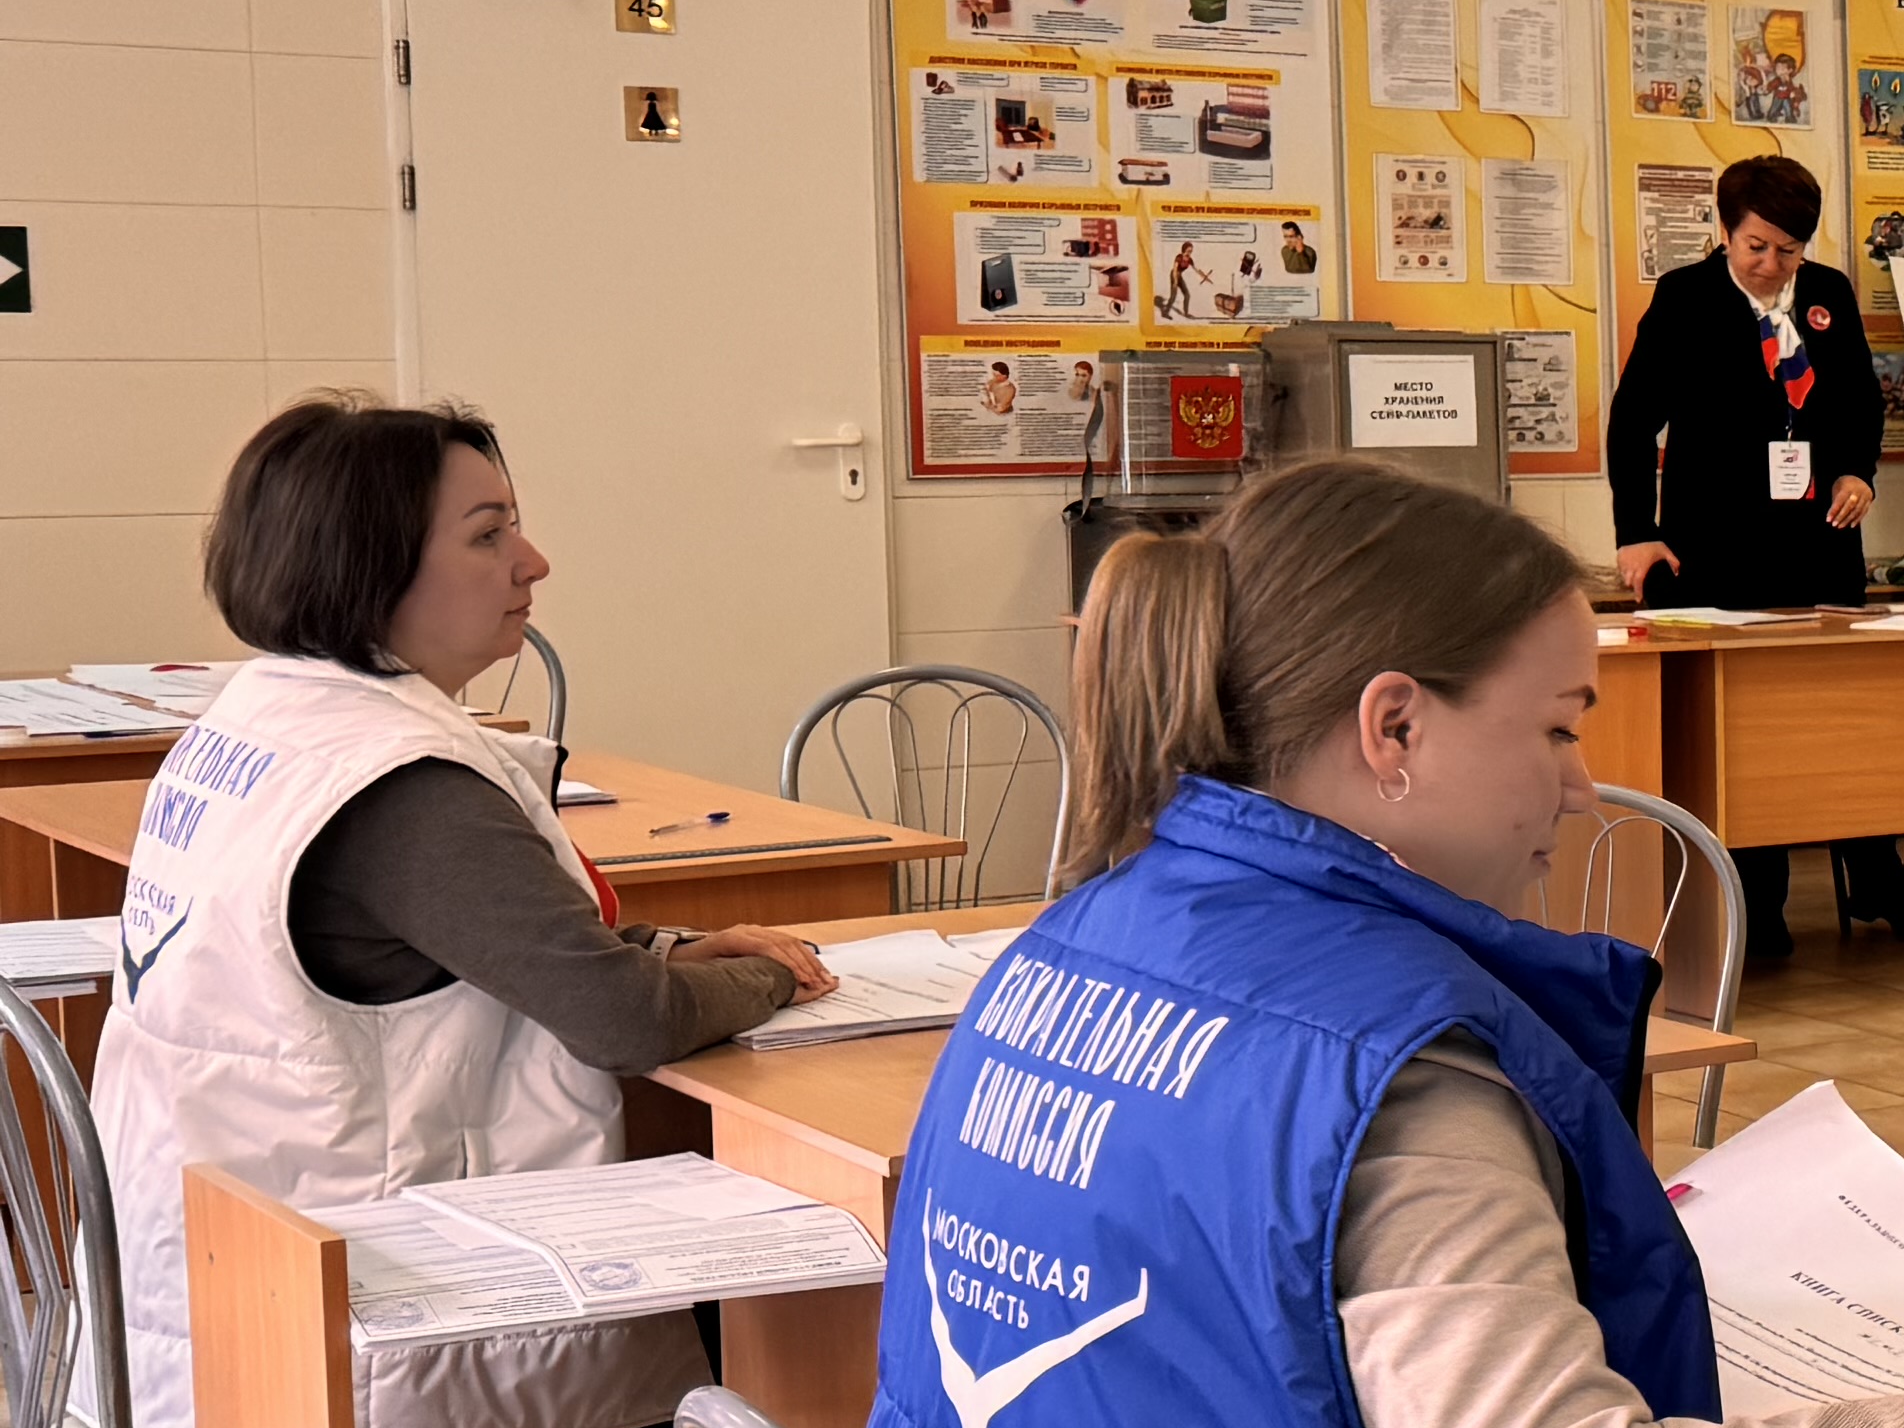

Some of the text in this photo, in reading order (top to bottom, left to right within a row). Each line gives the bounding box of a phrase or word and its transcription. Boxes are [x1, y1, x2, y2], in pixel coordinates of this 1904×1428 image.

[1651, 83, 1676, 99] 112
[1393, 382, 1434, 392] МЕСТО
[974, 952, 1229, 1099] ИЗБИРАТЕЛЬНАЯ
[959, 1057, 1115, 1190] КОМИССИЯ
[932, 1207, 1090, 1302] МОСКОВСКАЯ
[947, 1269, 1029, 1329] ОБЛАСТЬ
